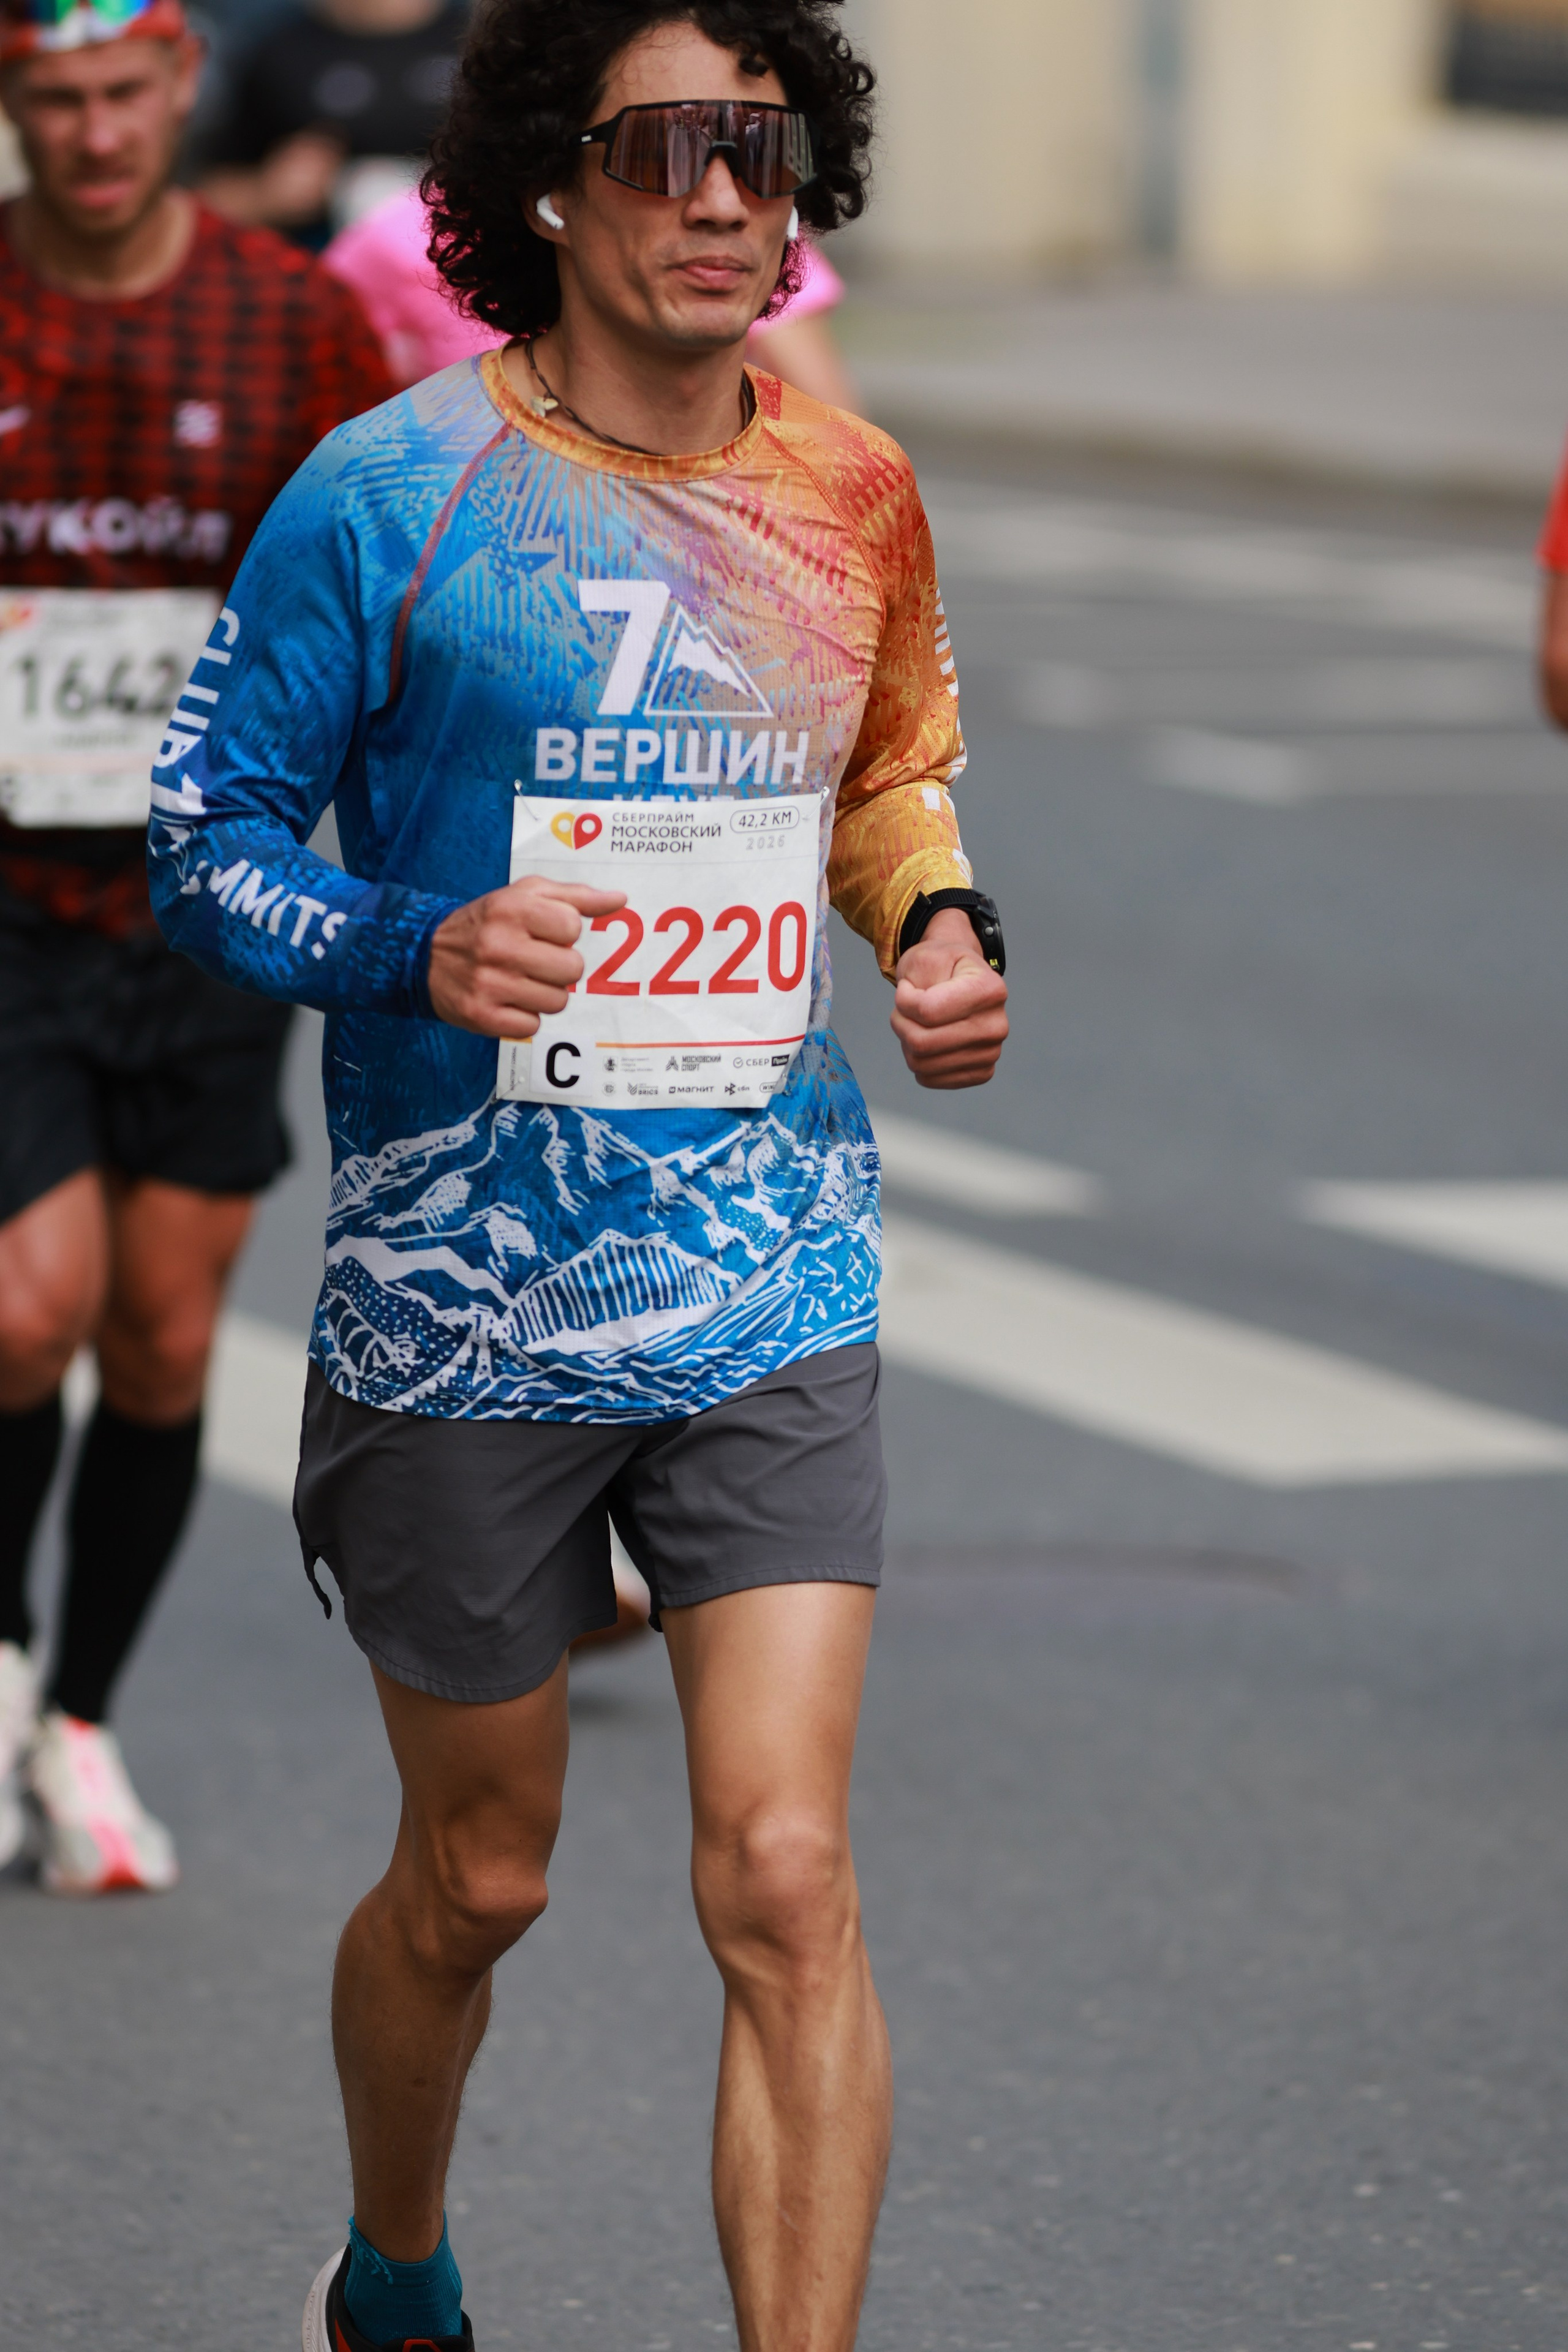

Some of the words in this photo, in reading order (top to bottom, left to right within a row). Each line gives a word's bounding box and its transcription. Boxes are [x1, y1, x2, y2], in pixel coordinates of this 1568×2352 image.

[578, 579, 671, 715] 7
[535, 728, 809, 785] ВЕРШИН
[612, 812, 694, 823] СБЕРПРАЙМ
[738, 813, 767, 829] 42,2
[611, 823, 722, 838] МОСКОВСКИЙ
[611, 840, 693, 853] МАРАФОН
[745, 835, 785, 850] 2026
[180, 859, 347, 960] SMMITS
[567, 900, 807, 996] 2220
[682, 1054, 722, 1063] МОСКОВСКИЙ
